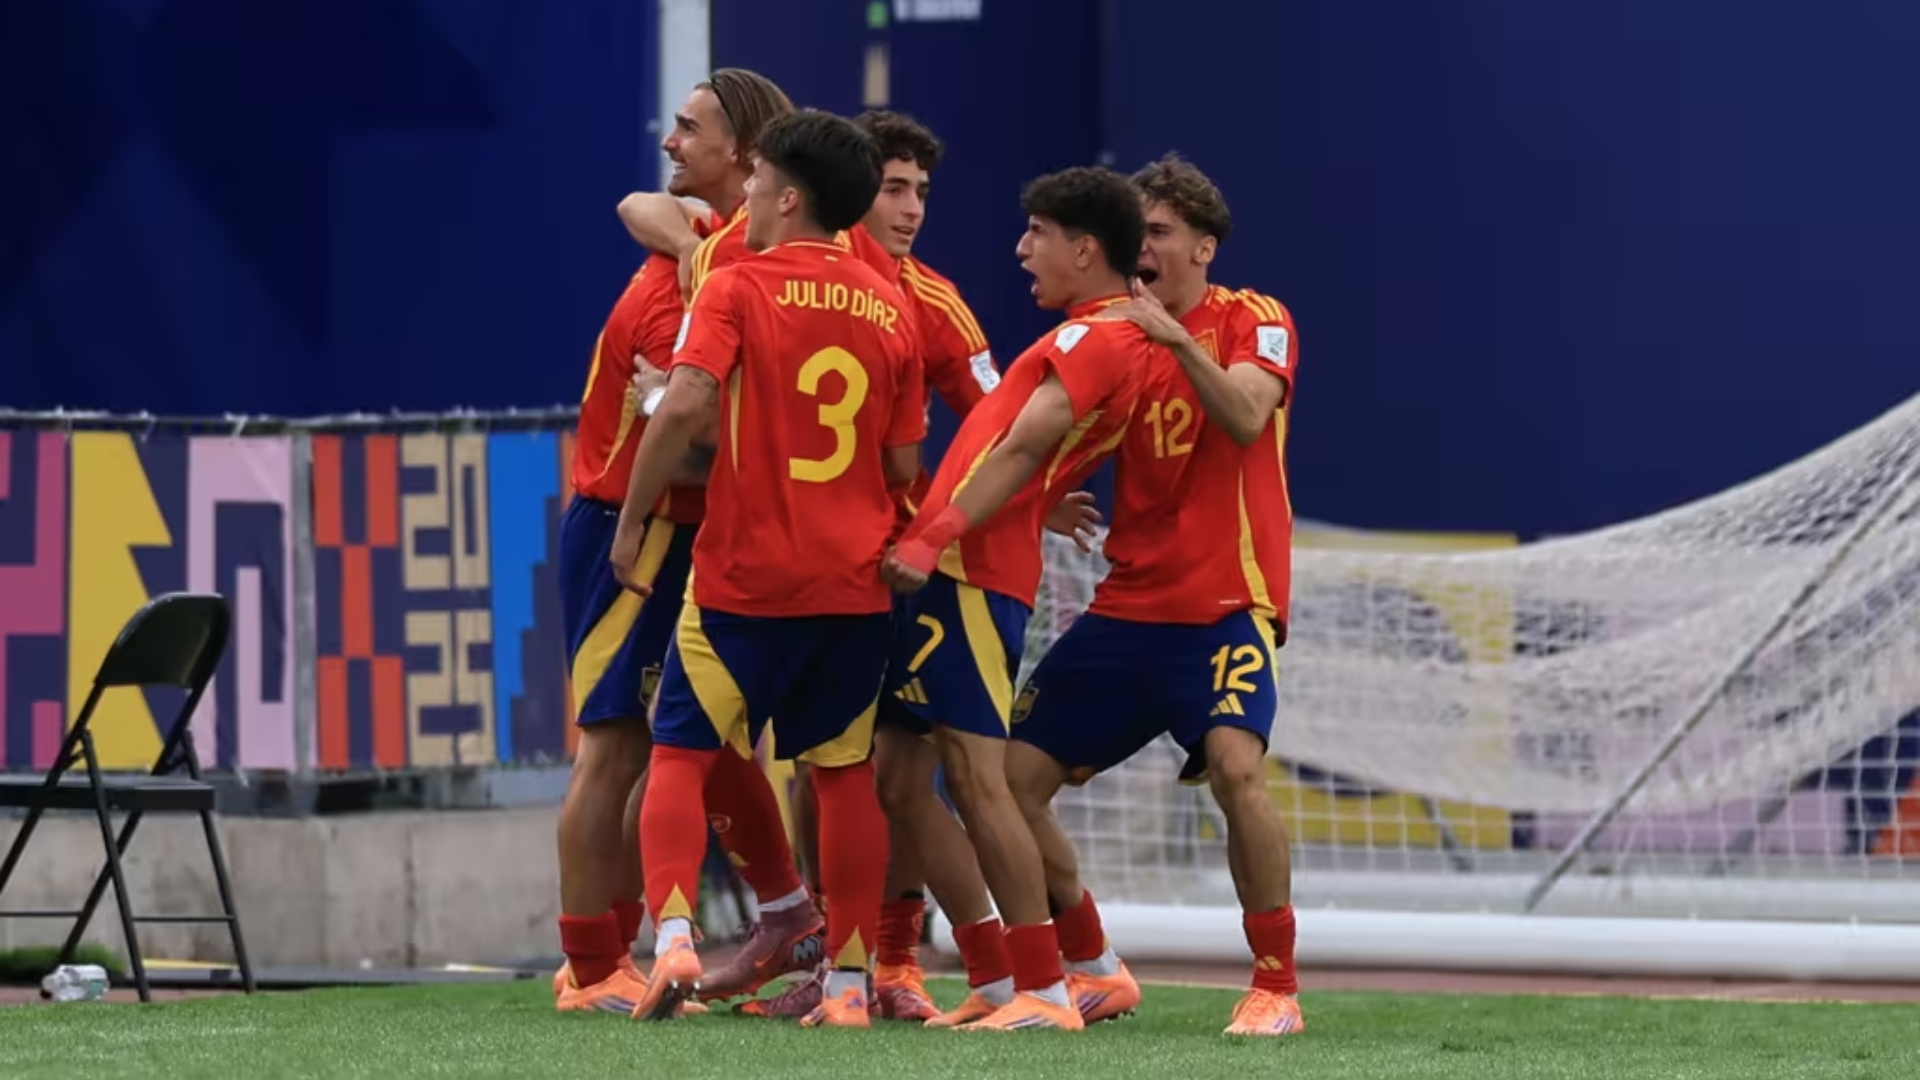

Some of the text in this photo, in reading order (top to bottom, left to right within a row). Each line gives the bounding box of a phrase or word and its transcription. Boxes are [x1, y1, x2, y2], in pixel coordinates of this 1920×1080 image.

[775, 280, 899, 335] JULIO DÍAZ
[788, 345, 869, 483] 3
[1144, 397, 1194, 458] 12
[907, 614, 945, 673] 7
[1210, 644, 1265, 694] 12
